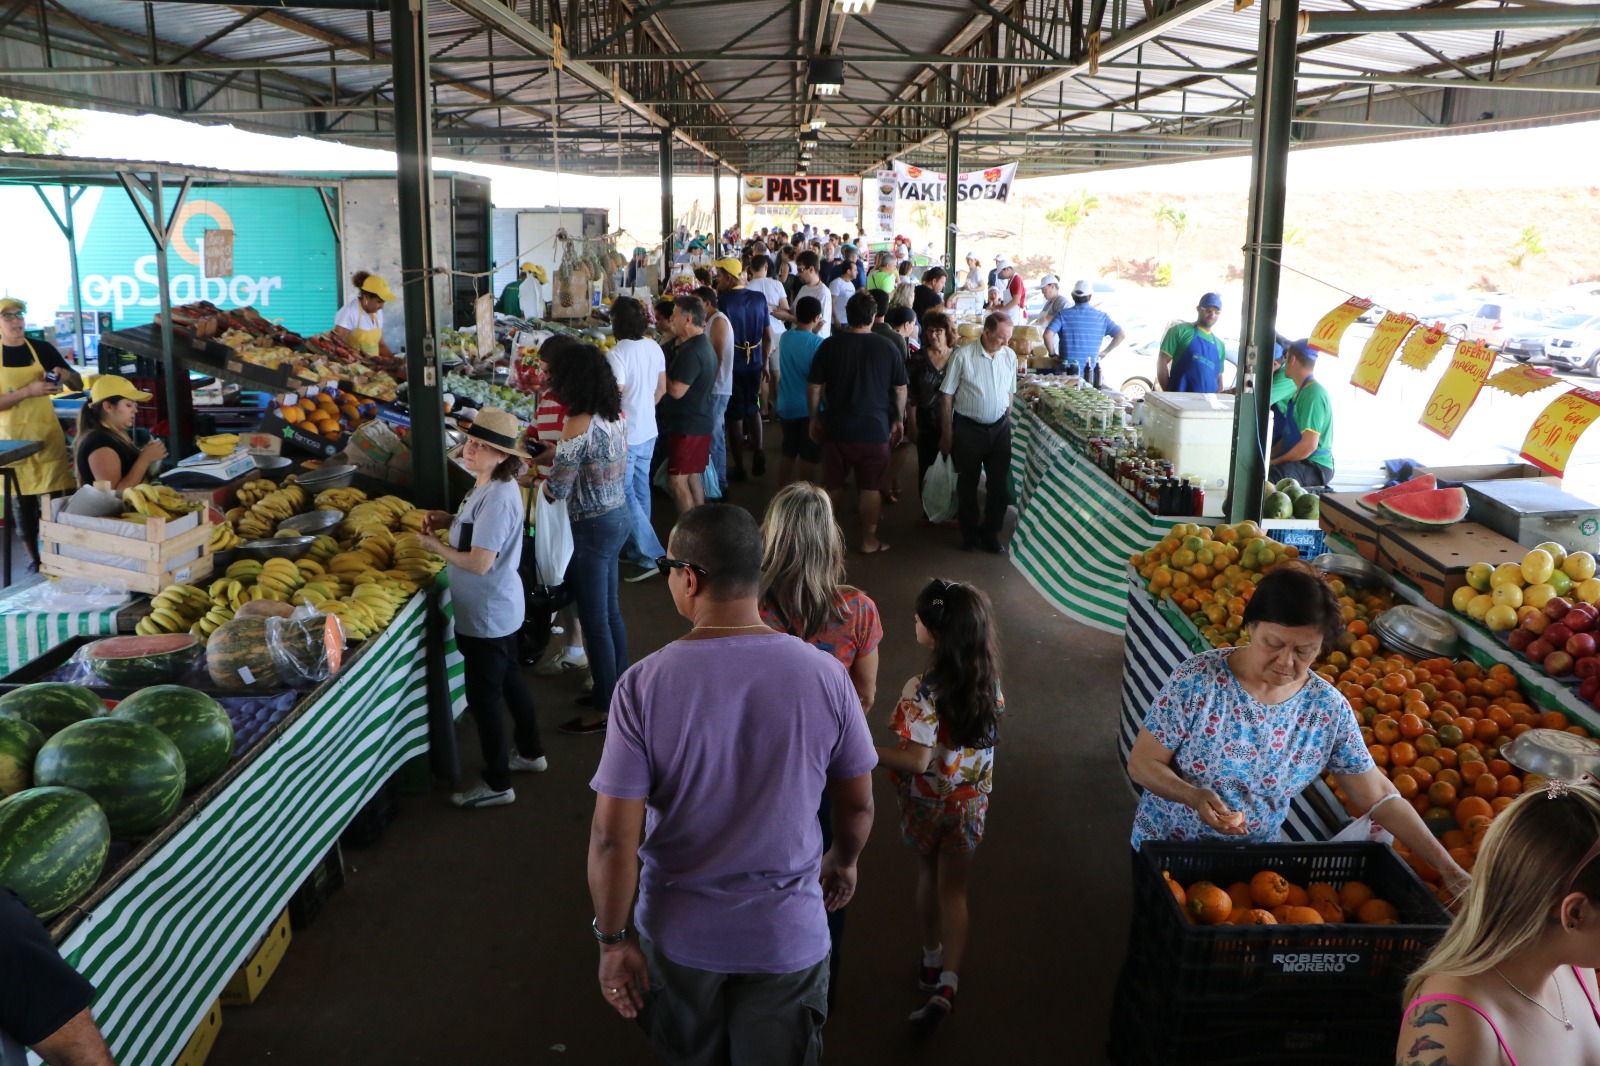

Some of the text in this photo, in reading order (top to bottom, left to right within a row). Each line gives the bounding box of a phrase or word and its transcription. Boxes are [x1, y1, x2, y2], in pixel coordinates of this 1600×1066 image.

[766, 178, 842, 202] PASTEL
[1386, 313, 1413, 325] OFERTA
[1459, 345, 1491, 362] OFERTA
[294, 431, 320, 449] famosa
[1272, 953, 1360, 963] ROBERTO
[1282, 962, 1346, 972] MORENO
